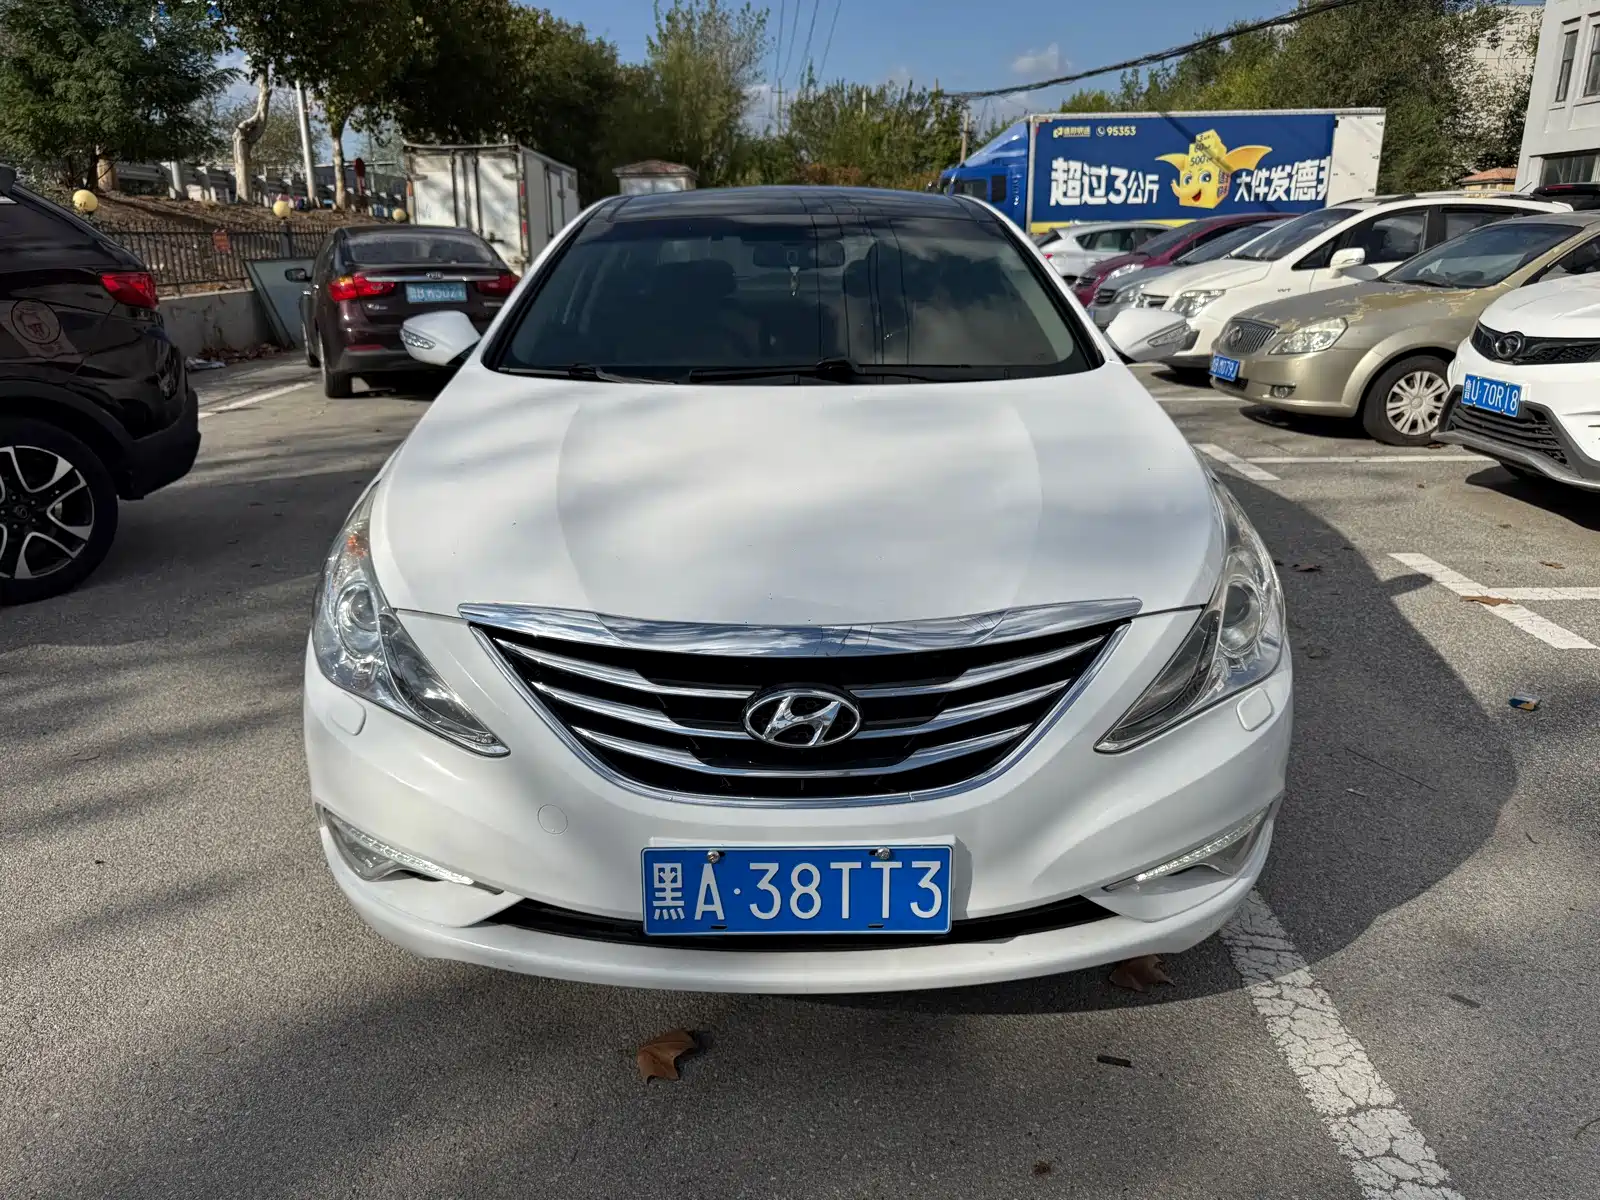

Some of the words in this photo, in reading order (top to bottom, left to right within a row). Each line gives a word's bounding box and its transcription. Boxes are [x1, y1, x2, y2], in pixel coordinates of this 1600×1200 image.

[1106, 126, 1136, 136] 95353
[1049, 156, 1159, 206] 超过3公斤
[653, 860, 943, 920] 黑A·38TT3
